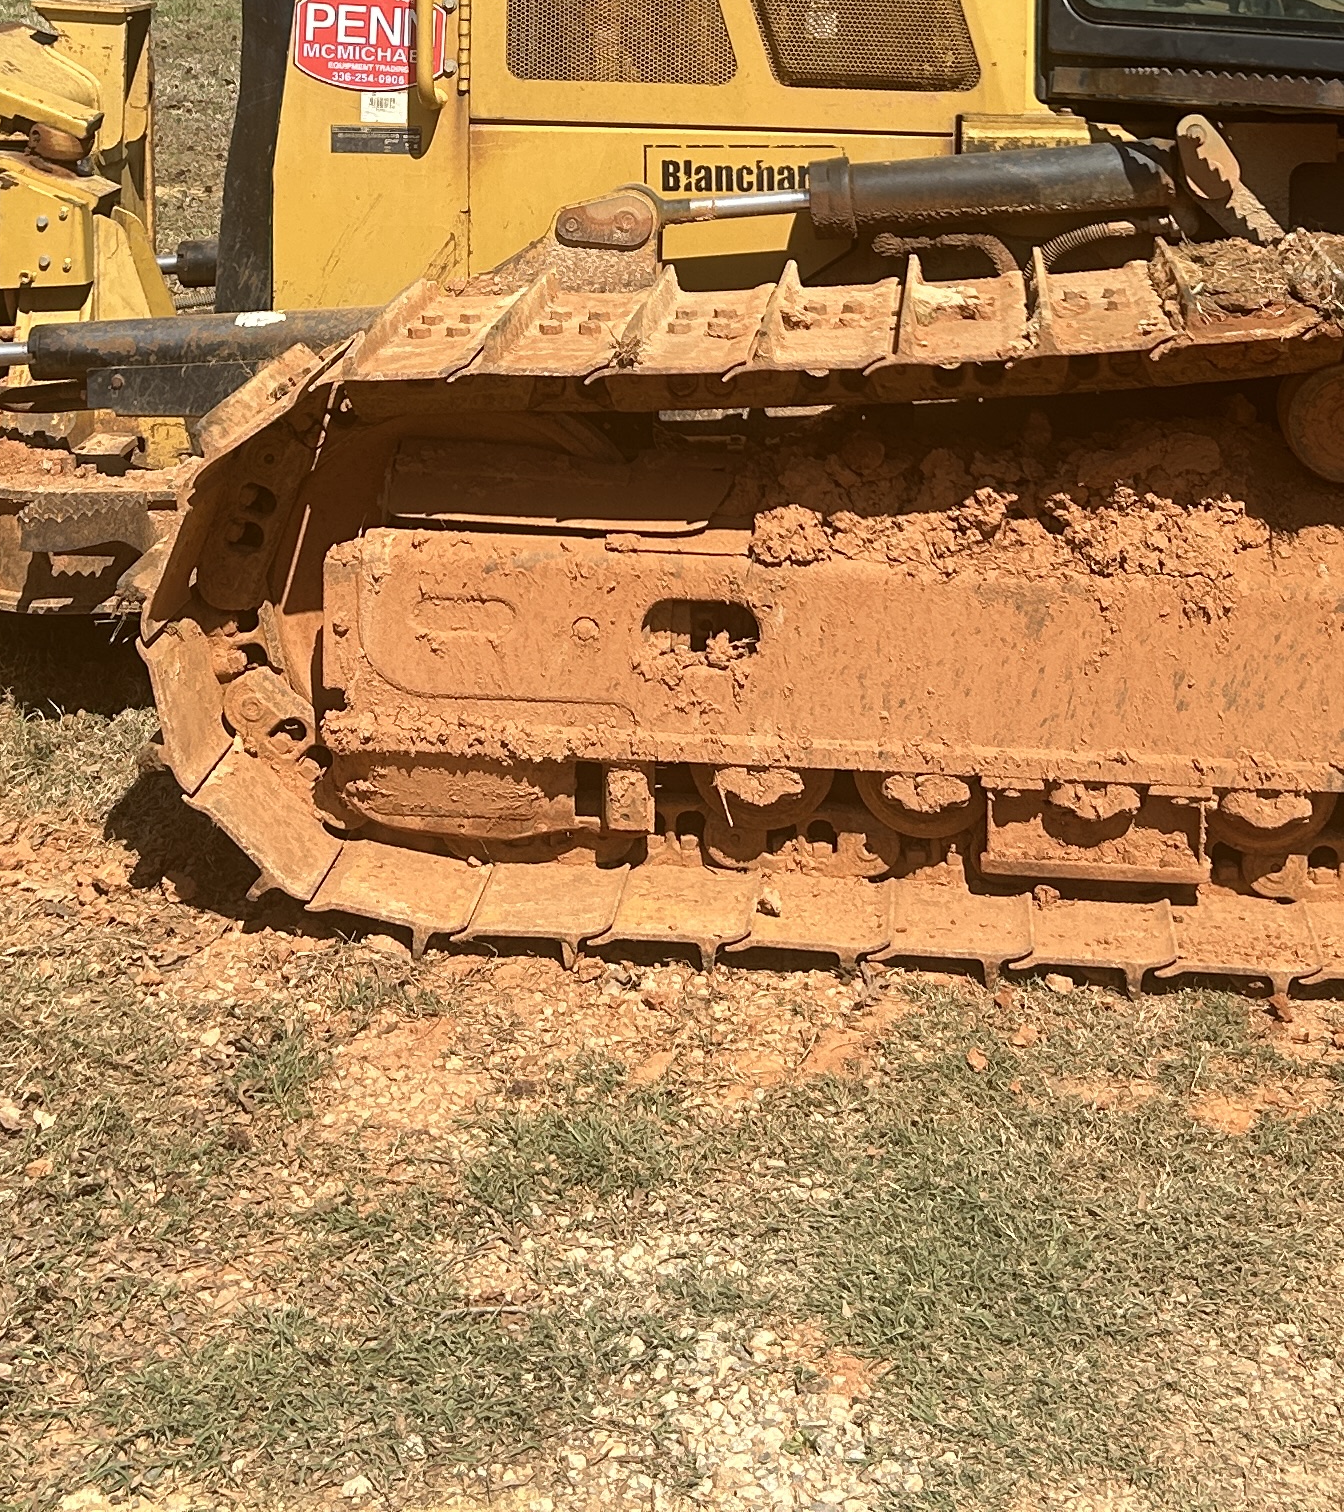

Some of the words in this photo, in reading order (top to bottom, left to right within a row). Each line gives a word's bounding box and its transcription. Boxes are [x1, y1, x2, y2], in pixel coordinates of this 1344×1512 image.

[303, 43, 417, 63] MCMICHAE
[327, 61, 374, 72] EQUIPMENT
[375, 64, 409, 74] TRADING
[661, 159, 810, 192] Blanchar
